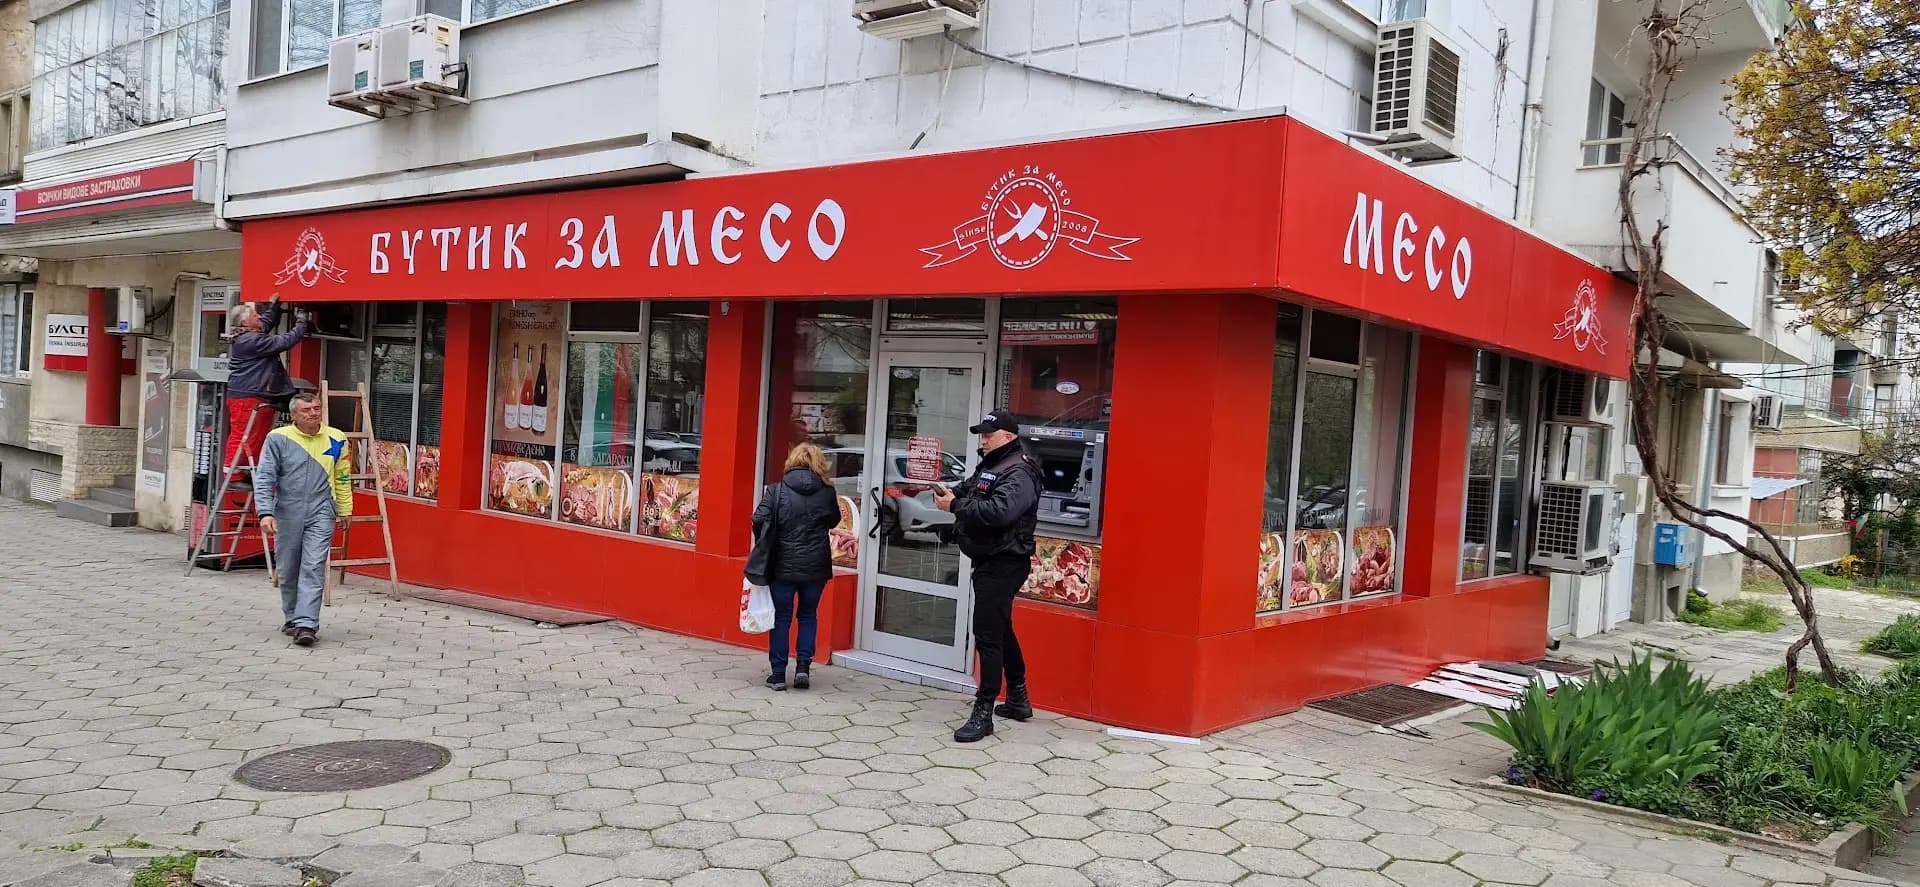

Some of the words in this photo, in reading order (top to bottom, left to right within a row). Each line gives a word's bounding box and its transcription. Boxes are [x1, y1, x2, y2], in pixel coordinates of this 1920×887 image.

[37, 190, 63, 204] ВСИЧКИ
[62, 184, 89, 201] ВИДОВЕ
[89, 175, 142, 196] ЗАСТРАХОВКИ
[370, 221, 528, 275] БУТИК
[554, 215, 621, 270] ЗА
[649, 198, 846, 267] МЕСО
[1061, 220, 1088, 233] 2008
[1343, 191, 1472, 300] МЕСО
[48, 324, 88, 335] БУЛСТ
